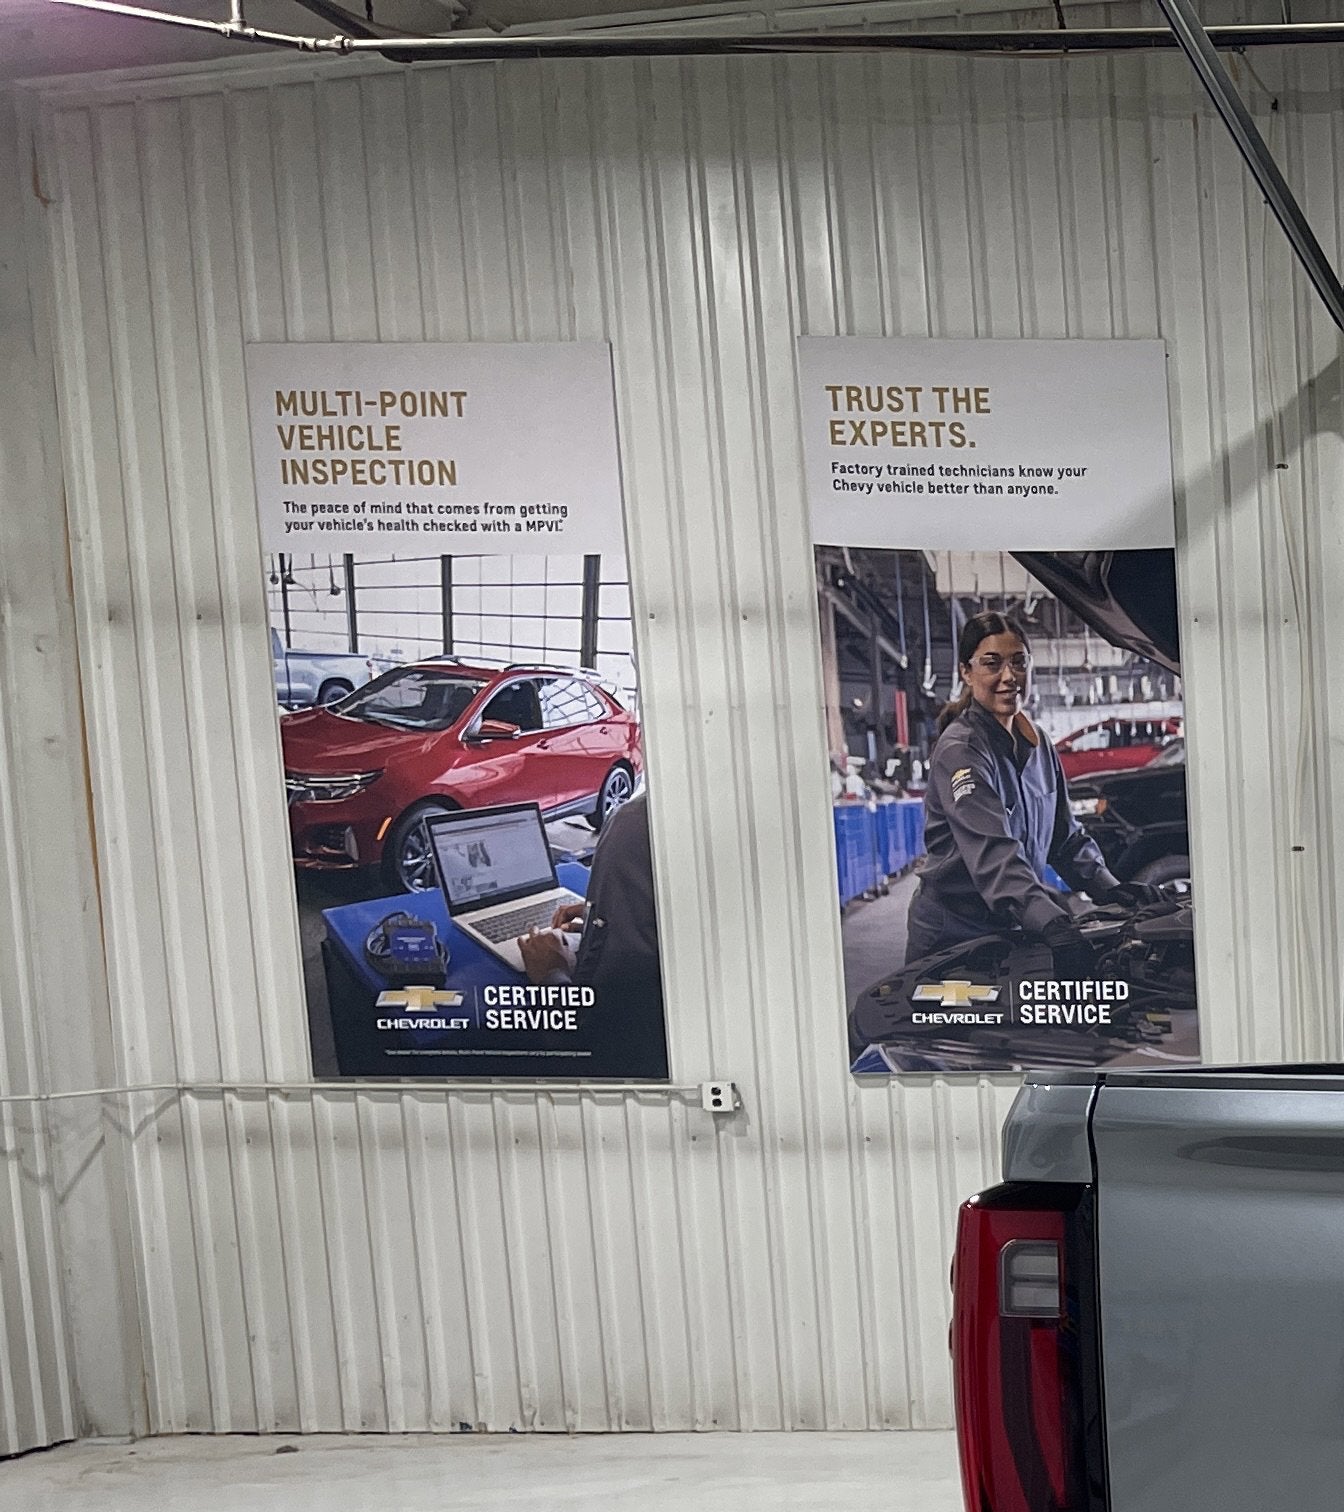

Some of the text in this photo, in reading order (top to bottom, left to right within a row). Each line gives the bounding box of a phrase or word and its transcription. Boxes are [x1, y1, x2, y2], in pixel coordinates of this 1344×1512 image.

[275, 390, 467, 418] MULTI-POINT
[825, 385, 991, 414] TRUST THE
[277, 424, 402, 451] VEHICLE
[829, 420, 976, 448] EXPERTS.
[281, 458, 458, 486] INSPECTION
[831, 461, 1088, 480] Factory trained technicians know your
[832, 478, 1059, 498] Chevy vehicle better than anyone.
[284, 501, 568, 519] The peace of mind that comes from getting
[285, 520, 315, 534] your
[318, 518, 374, 532] vehicle's
[378, 518, 419, 532] health
[423, 519, 477, 533] checked
[481, 519, 510, 533] with
[514, 522, 522, 533] a
[483, 985, 596, 1007] CERTIFIED
[1018, 980, 1129, 1001] CERTIFIED
[376, 1018, 470, 1030] CHEVROLET
[485, 1009, 578, 1030] SERVICE
[911, 1012, 1004, 1025] CHEVROLET
[1019, 1004, 1112, 1024] SERVICE
